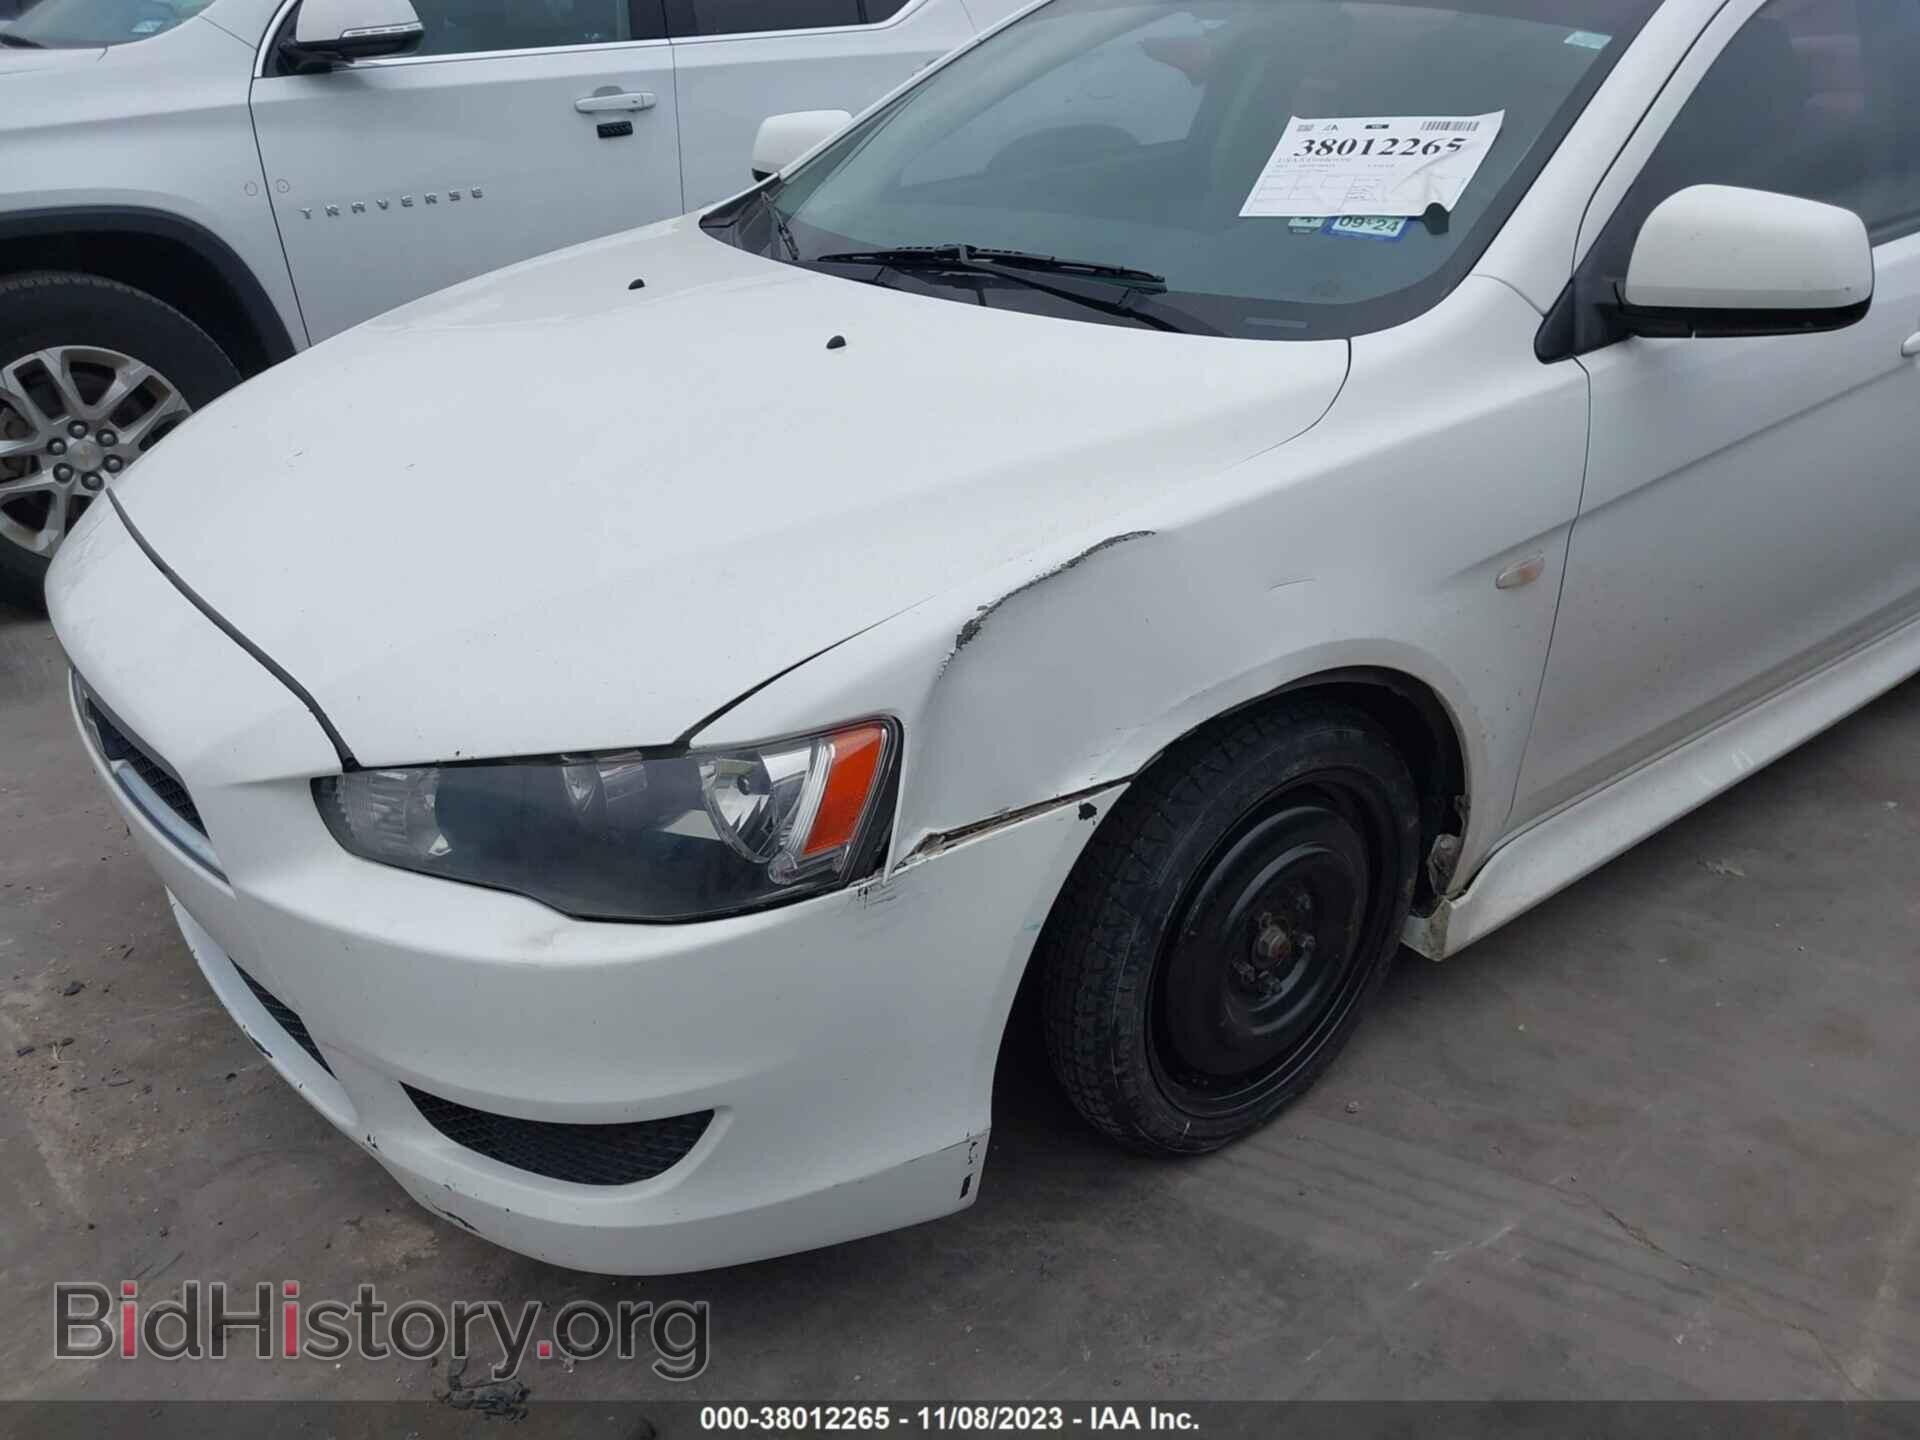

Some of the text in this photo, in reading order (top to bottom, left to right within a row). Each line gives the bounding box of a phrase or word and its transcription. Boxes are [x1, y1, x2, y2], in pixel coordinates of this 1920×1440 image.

[1293, 138, 1467, 156] 38012265
[300, 186, 483, 219] TRAVERSE
[1372, 218, 1399, 232] 24
